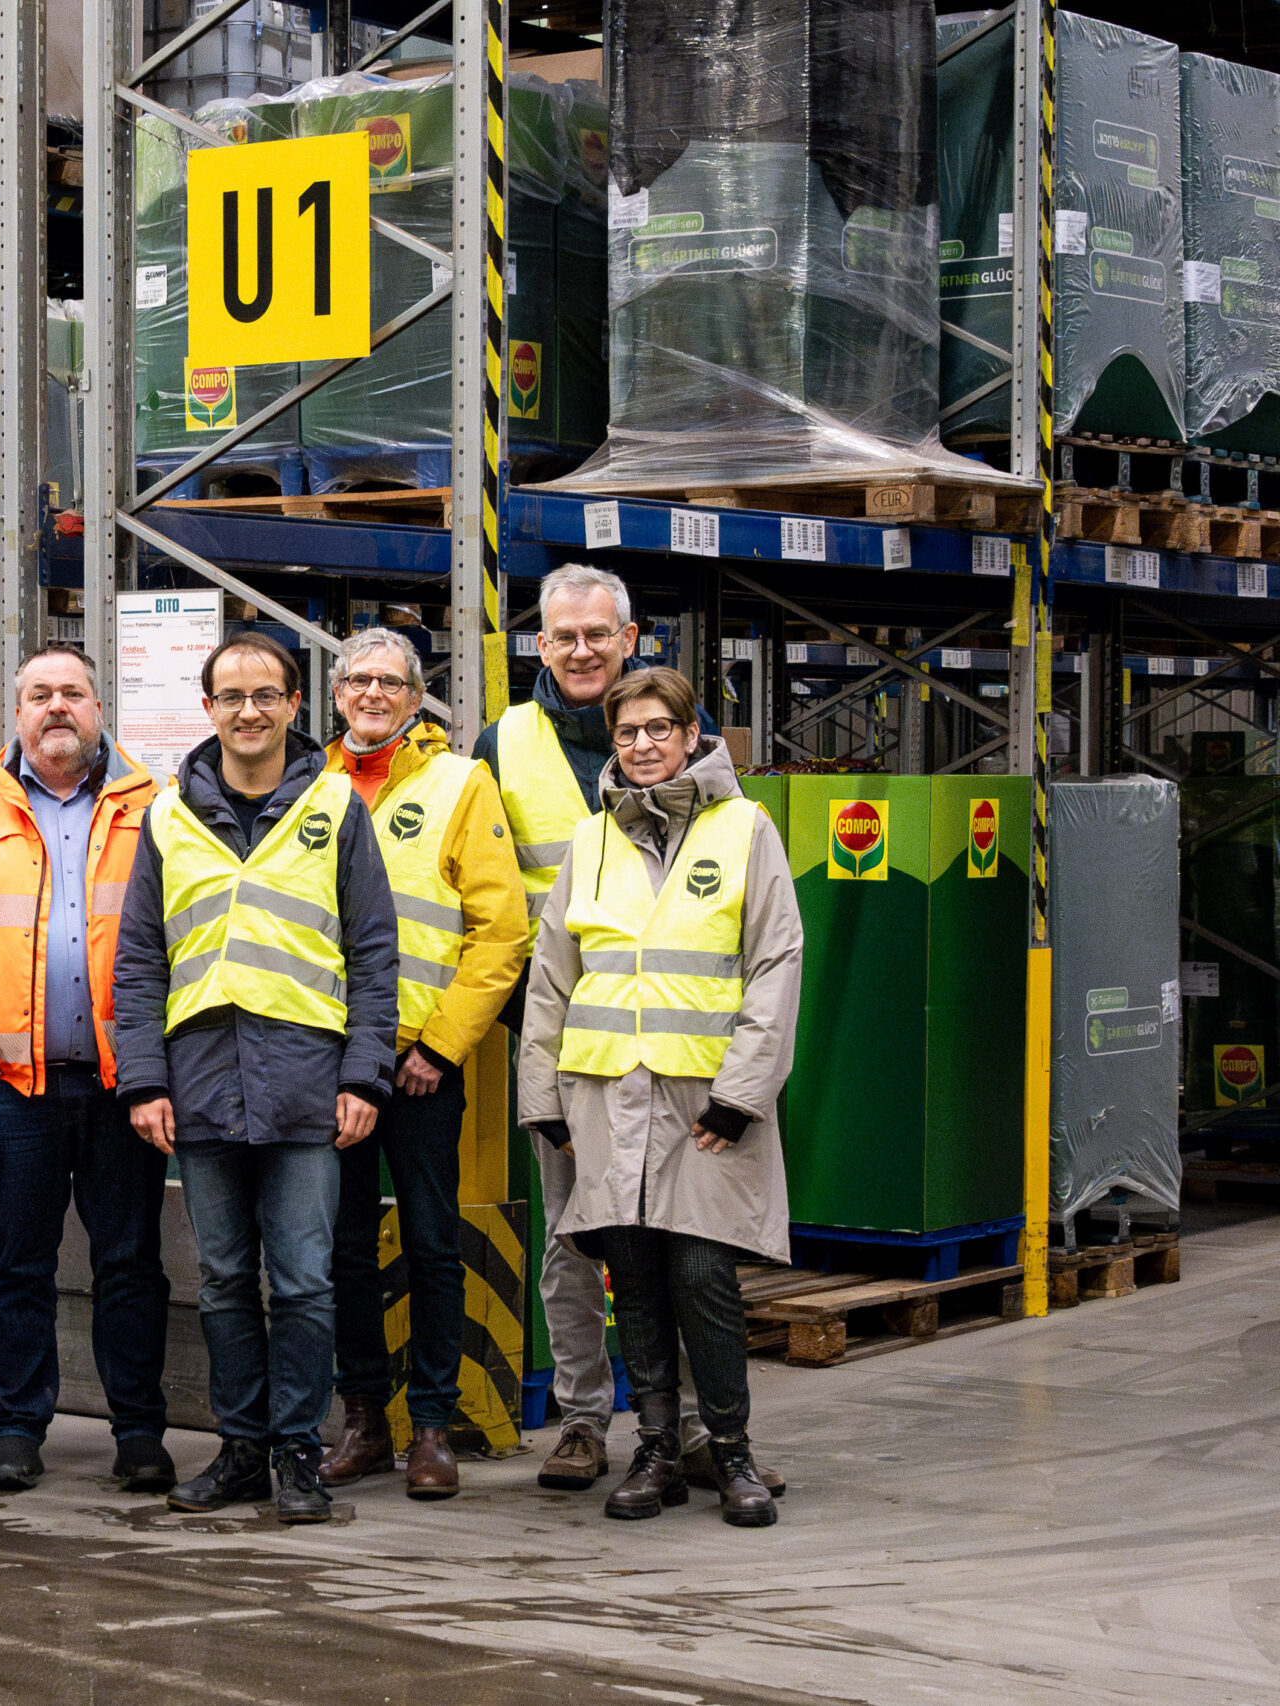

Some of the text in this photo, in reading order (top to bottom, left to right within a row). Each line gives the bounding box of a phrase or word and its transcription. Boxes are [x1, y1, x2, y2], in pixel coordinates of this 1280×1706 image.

[369, 132, 402, 150] OMPO
[223, 180, 331, 324] U1
[940, 268, 1014, 287] RTNERGLÜC
[192, 373, 228, 389] COMPO
[881, 492, 902, 508] EUR
[155, 598, 180, 613] BITO
[396, 808, 424, 823] COMPO
[304, 818, 331, 833] COMPO
[837, 818, 880, 835] COMPO
[973, 817, 995, 833] COMPO
[691, 866, 720, 877] COMPO
[1221, 1059, 1257, 1073] COMPO
